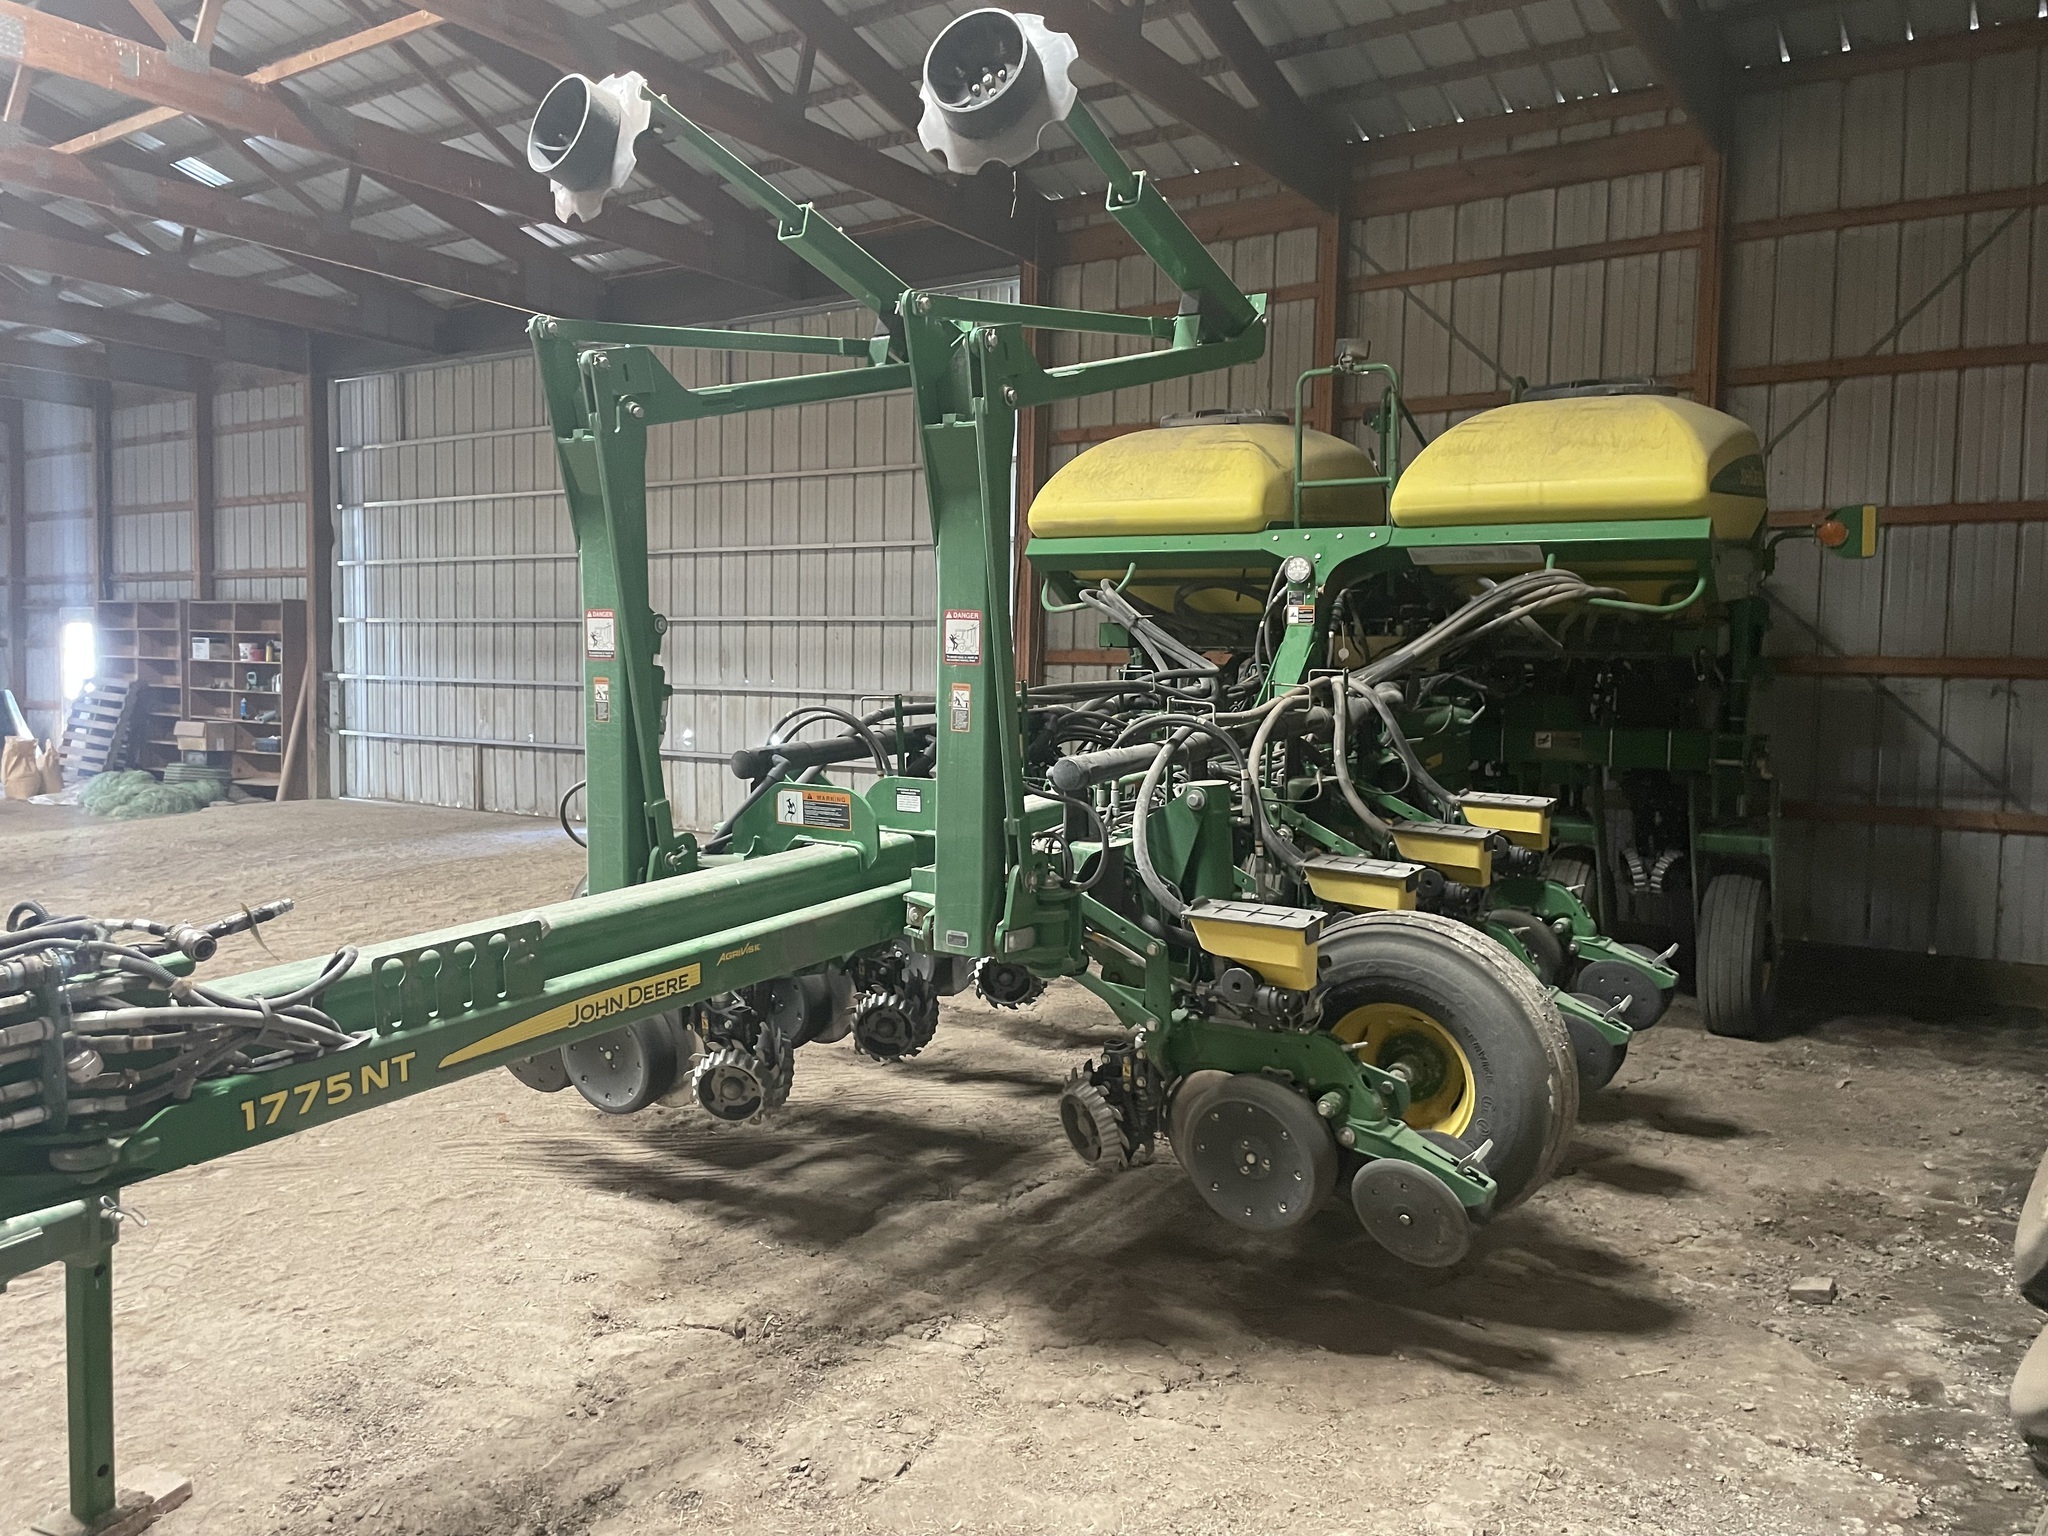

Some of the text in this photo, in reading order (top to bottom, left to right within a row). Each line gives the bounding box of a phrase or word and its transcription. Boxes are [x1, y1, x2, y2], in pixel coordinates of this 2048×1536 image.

[816, 795, 846, 803] WARNING
[568, 973, 689, 1026] JOHN DEERE
